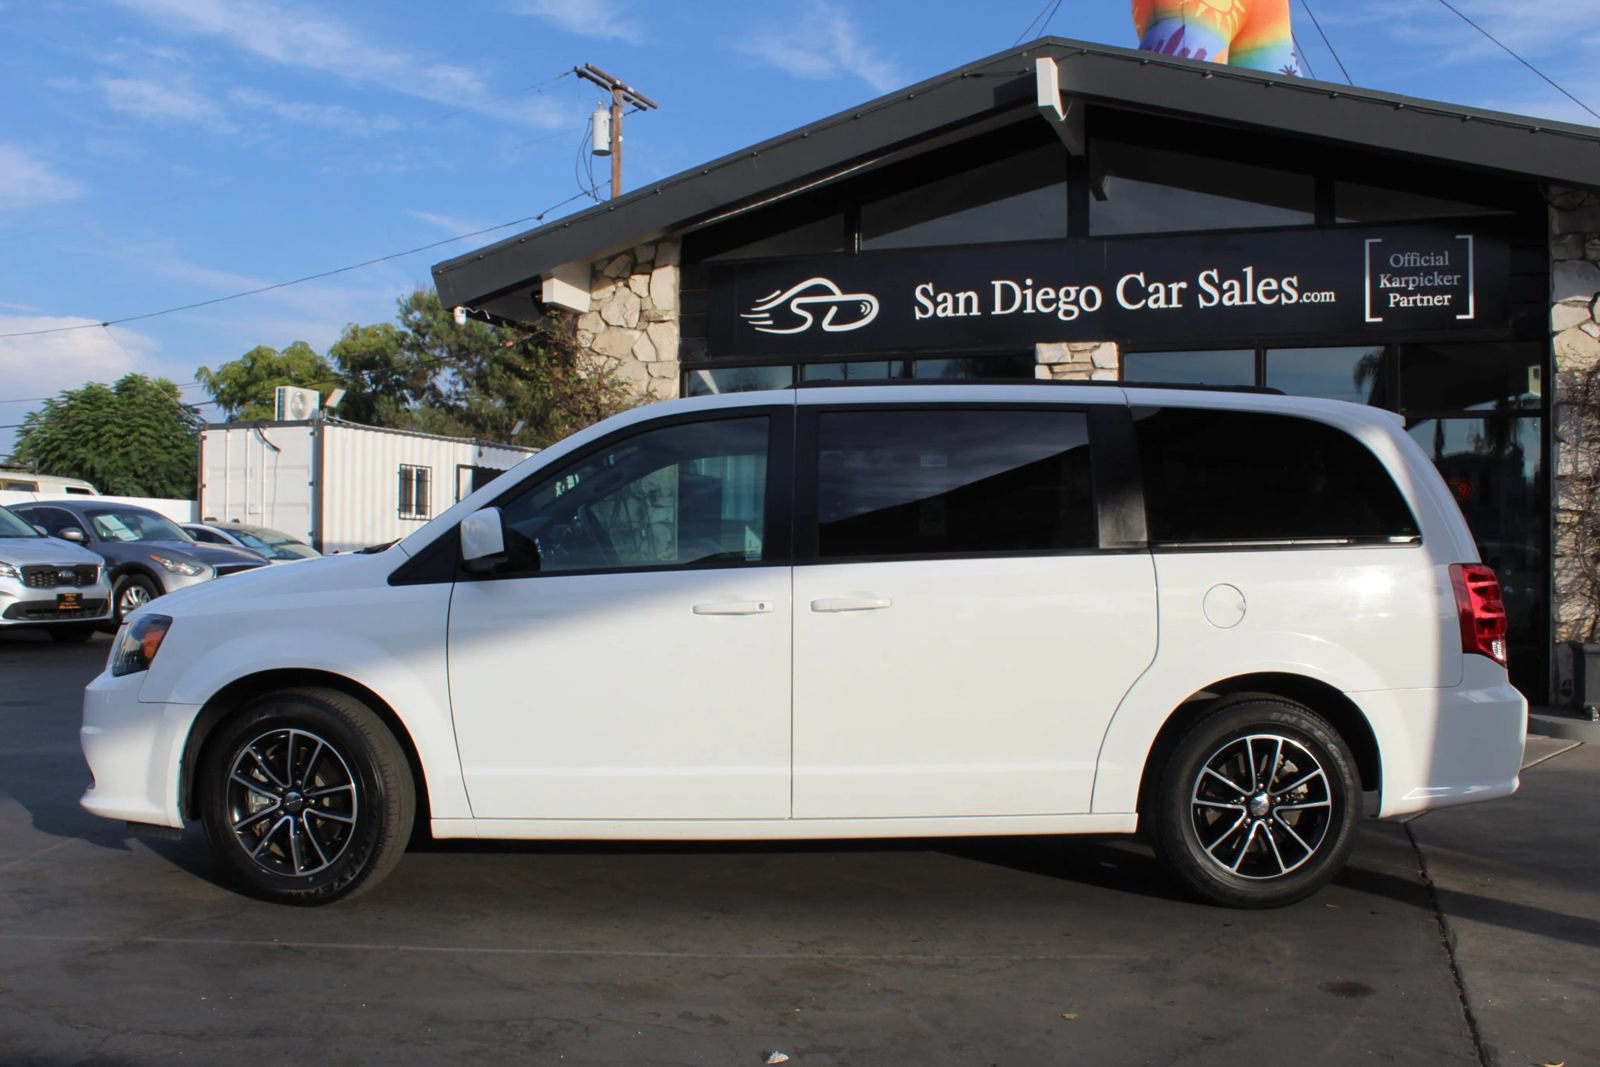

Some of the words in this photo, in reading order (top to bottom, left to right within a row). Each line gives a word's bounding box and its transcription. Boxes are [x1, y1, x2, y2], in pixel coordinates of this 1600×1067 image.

[1389, 250, 1449, 268] Official
[1379, 271, 1461, 290] Karpicker
[914, 282, 982, 321] San
[991, 278, 1103, 321] Diego
[1115, 271, 1188, 310] Car
[1388, 291, 1452, 308] Partner
